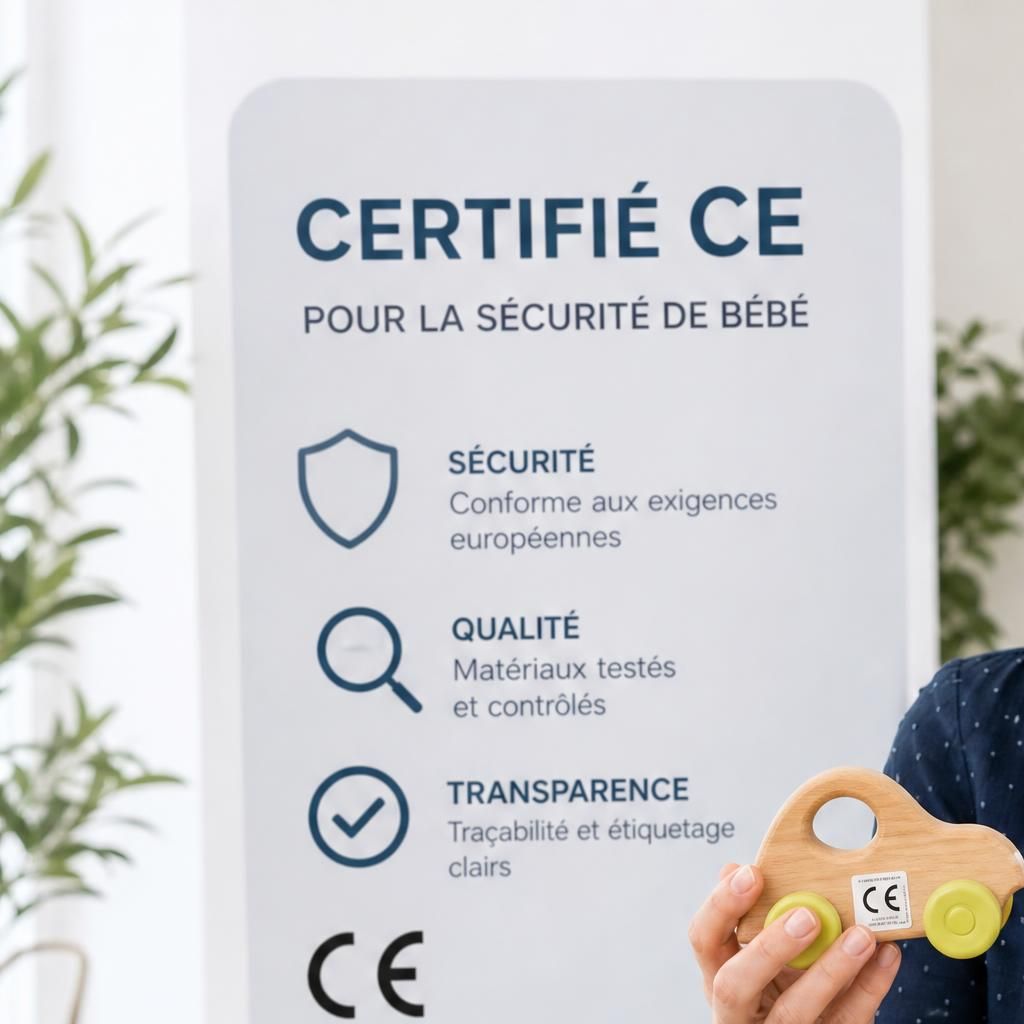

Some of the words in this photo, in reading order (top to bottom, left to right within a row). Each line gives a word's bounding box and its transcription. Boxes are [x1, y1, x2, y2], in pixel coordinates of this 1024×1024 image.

[297, 181, 659, 261] CERTIFIÉ
[690, 186, 803, 257] CE
[304, 305, 405, 333] POUR
[421, 305, 463, 332] LA
[478, 296, 649, 331] SÉCURITÉ
[664, 302, 707, 328] DE
[722, 294, 808, 328] BÉBÉ
[449, 443, 594, 474] SÉCURITÉ
[450, 490, 581, 514] Conforme
[592, 496, 638, 512] aux
[648, 489, 777, 517] exigences
[451, 526, 621, 555] européennes
[452, 610, 579, 642] QUALITÉ
[454, 658, 586, 681] Matériaux
[597, 656, 676, 679] testés
[453, 697, 478, 718] et
[488, 693, 606, 717] contrôlés
[447, 778, 688, 804] TRANSPARENCE
[448, 820, 568, 847] Traçabilité
[577, 820, 599, 840] et
[608, 819, 735, 844] étiquetage
[449, 856, 511, 878] clairs
[863, 885, 900, 913] CE
[308, 931, 424, 1019] CE
